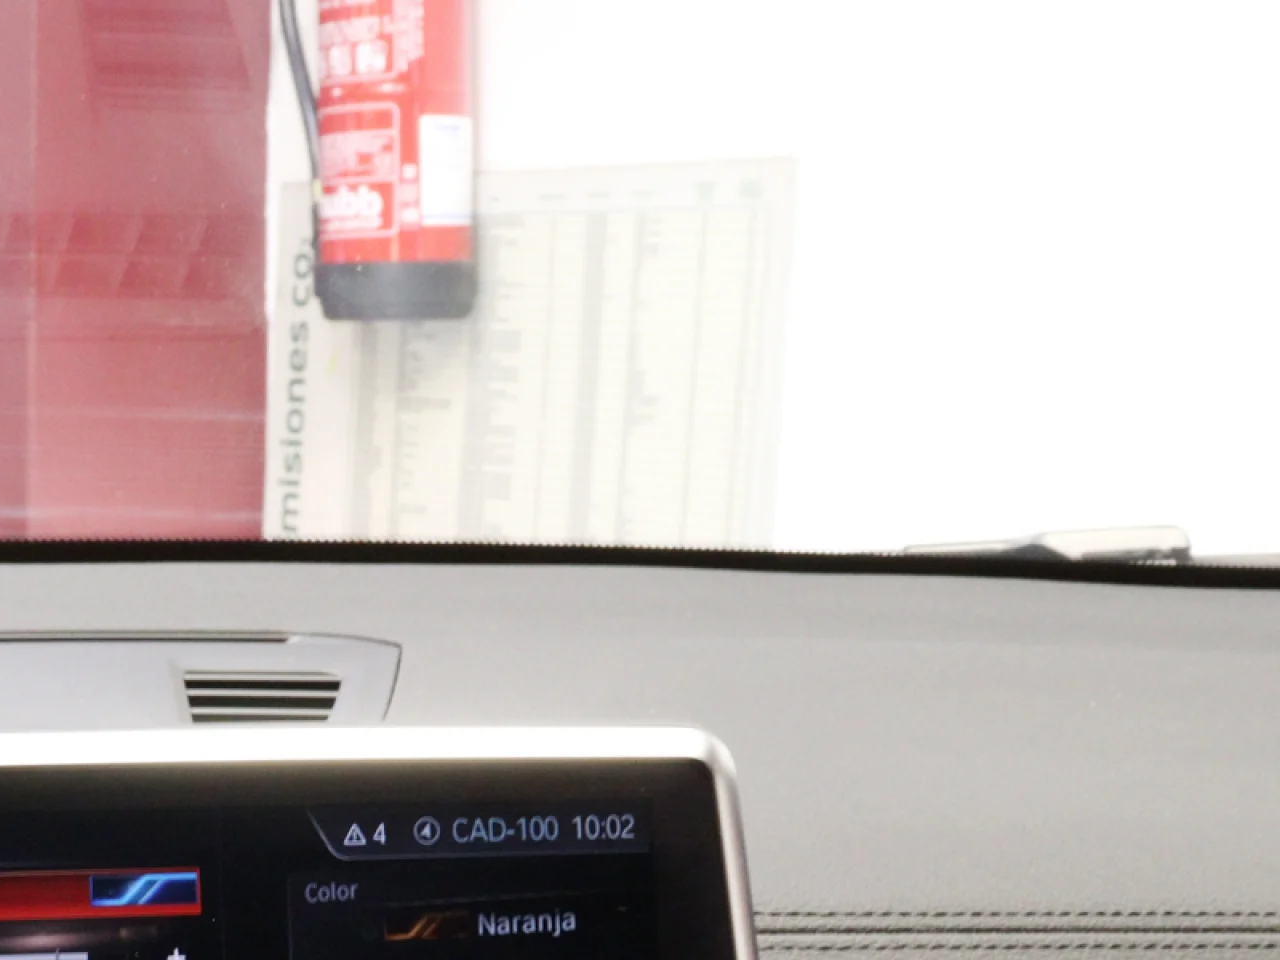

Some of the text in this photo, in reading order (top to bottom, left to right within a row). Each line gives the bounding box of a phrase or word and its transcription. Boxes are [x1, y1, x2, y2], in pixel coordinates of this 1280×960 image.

[372, 822, 387, 845] 4
[452, 815, 559, 842] CAD-100
[572, 813, 635, 840] 10:02
[304, 881, 358, 904] Color
[478, 909, 577, 938] Naranja
